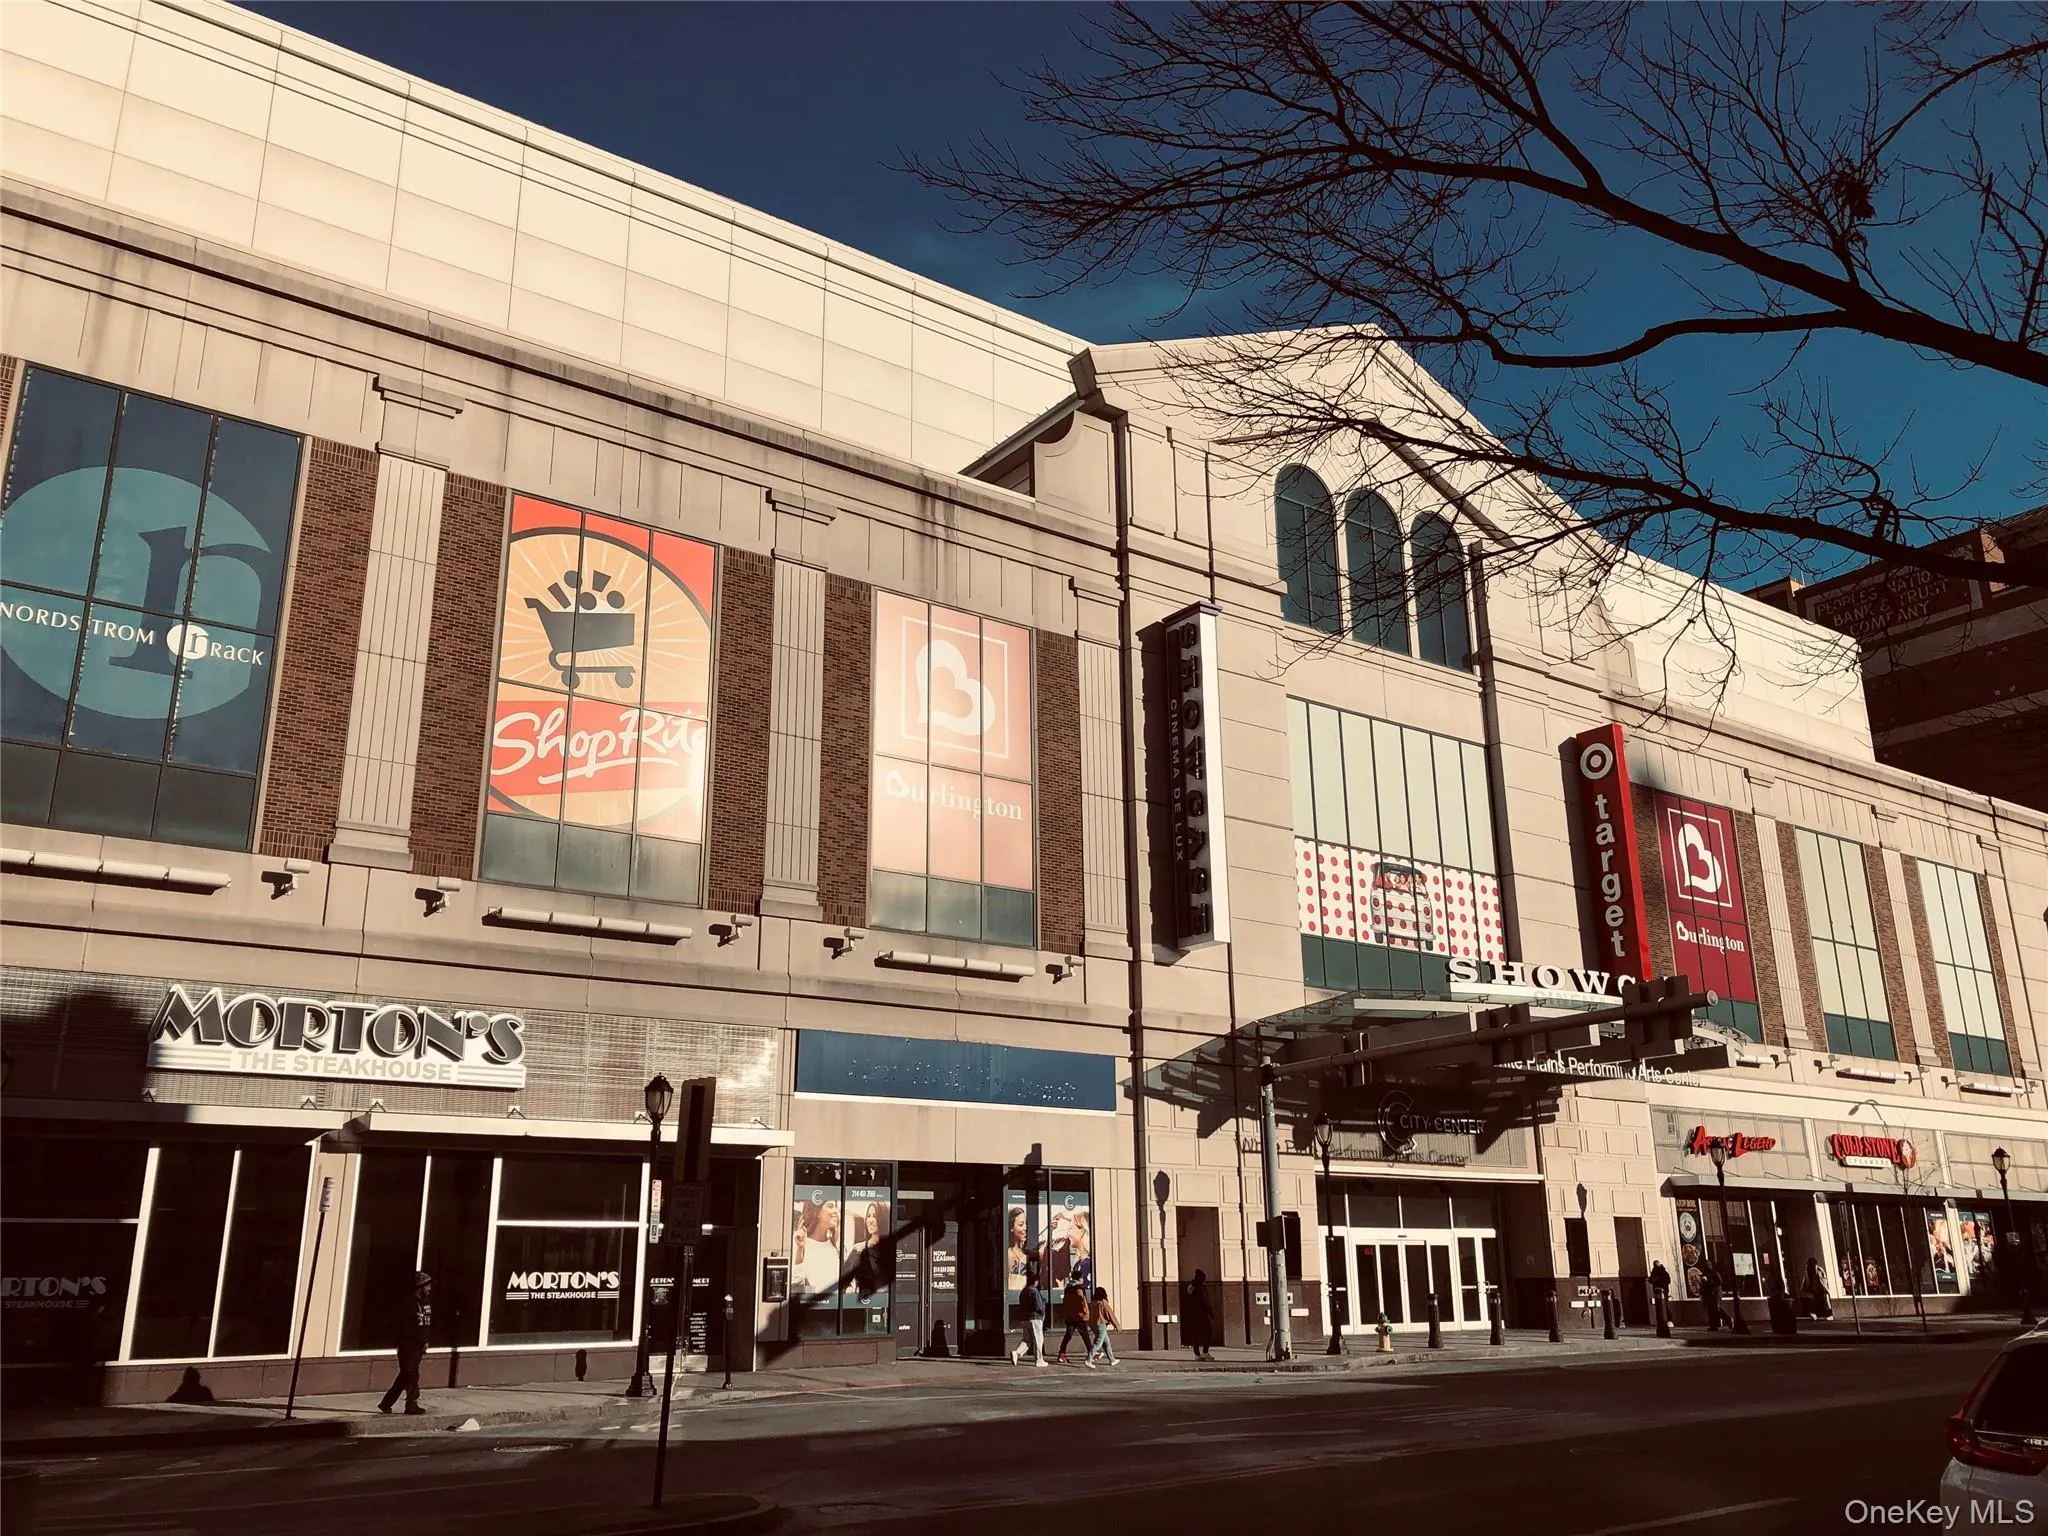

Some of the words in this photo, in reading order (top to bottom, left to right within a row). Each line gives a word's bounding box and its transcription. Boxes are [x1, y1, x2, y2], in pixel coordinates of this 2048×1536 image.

[0, 602, 155, 645] NORDSTROM
[1832, 602, 1875, 627] BANK
[491, 707, 707, 778] ShopRite
[1170, 698, 1180, 779] CINEMA
[885, 768, 1024, 823] Burlington
[1174, 822, 1184, 862] LUX
[1595, 793, 1626, 957] target
[1675, 919, 1746, 954] Burlington
[149, 984, 525, 1066] MORTON'S
[237, 1050, 287, 1072] THE
[292, 1054, 452, 1081] STEAKHOUSE
[1568, 1056, 1636, 1082] Performing
[1638, 1062, 1661, 1083] Arts
[1399, 1114, 1430, 1131] CITY
[1434, 1119, 1487, 1135] CENTER
[1832, 1134, 1863, 1160] COLD
[1861, 1136, 1901, 1164] STONE
[507, 1271, 620, 1290] MORTON'S
[530, 1291, 545, 1299] THE
[546, 1291, 597, 1299] STEAKHOUSE
